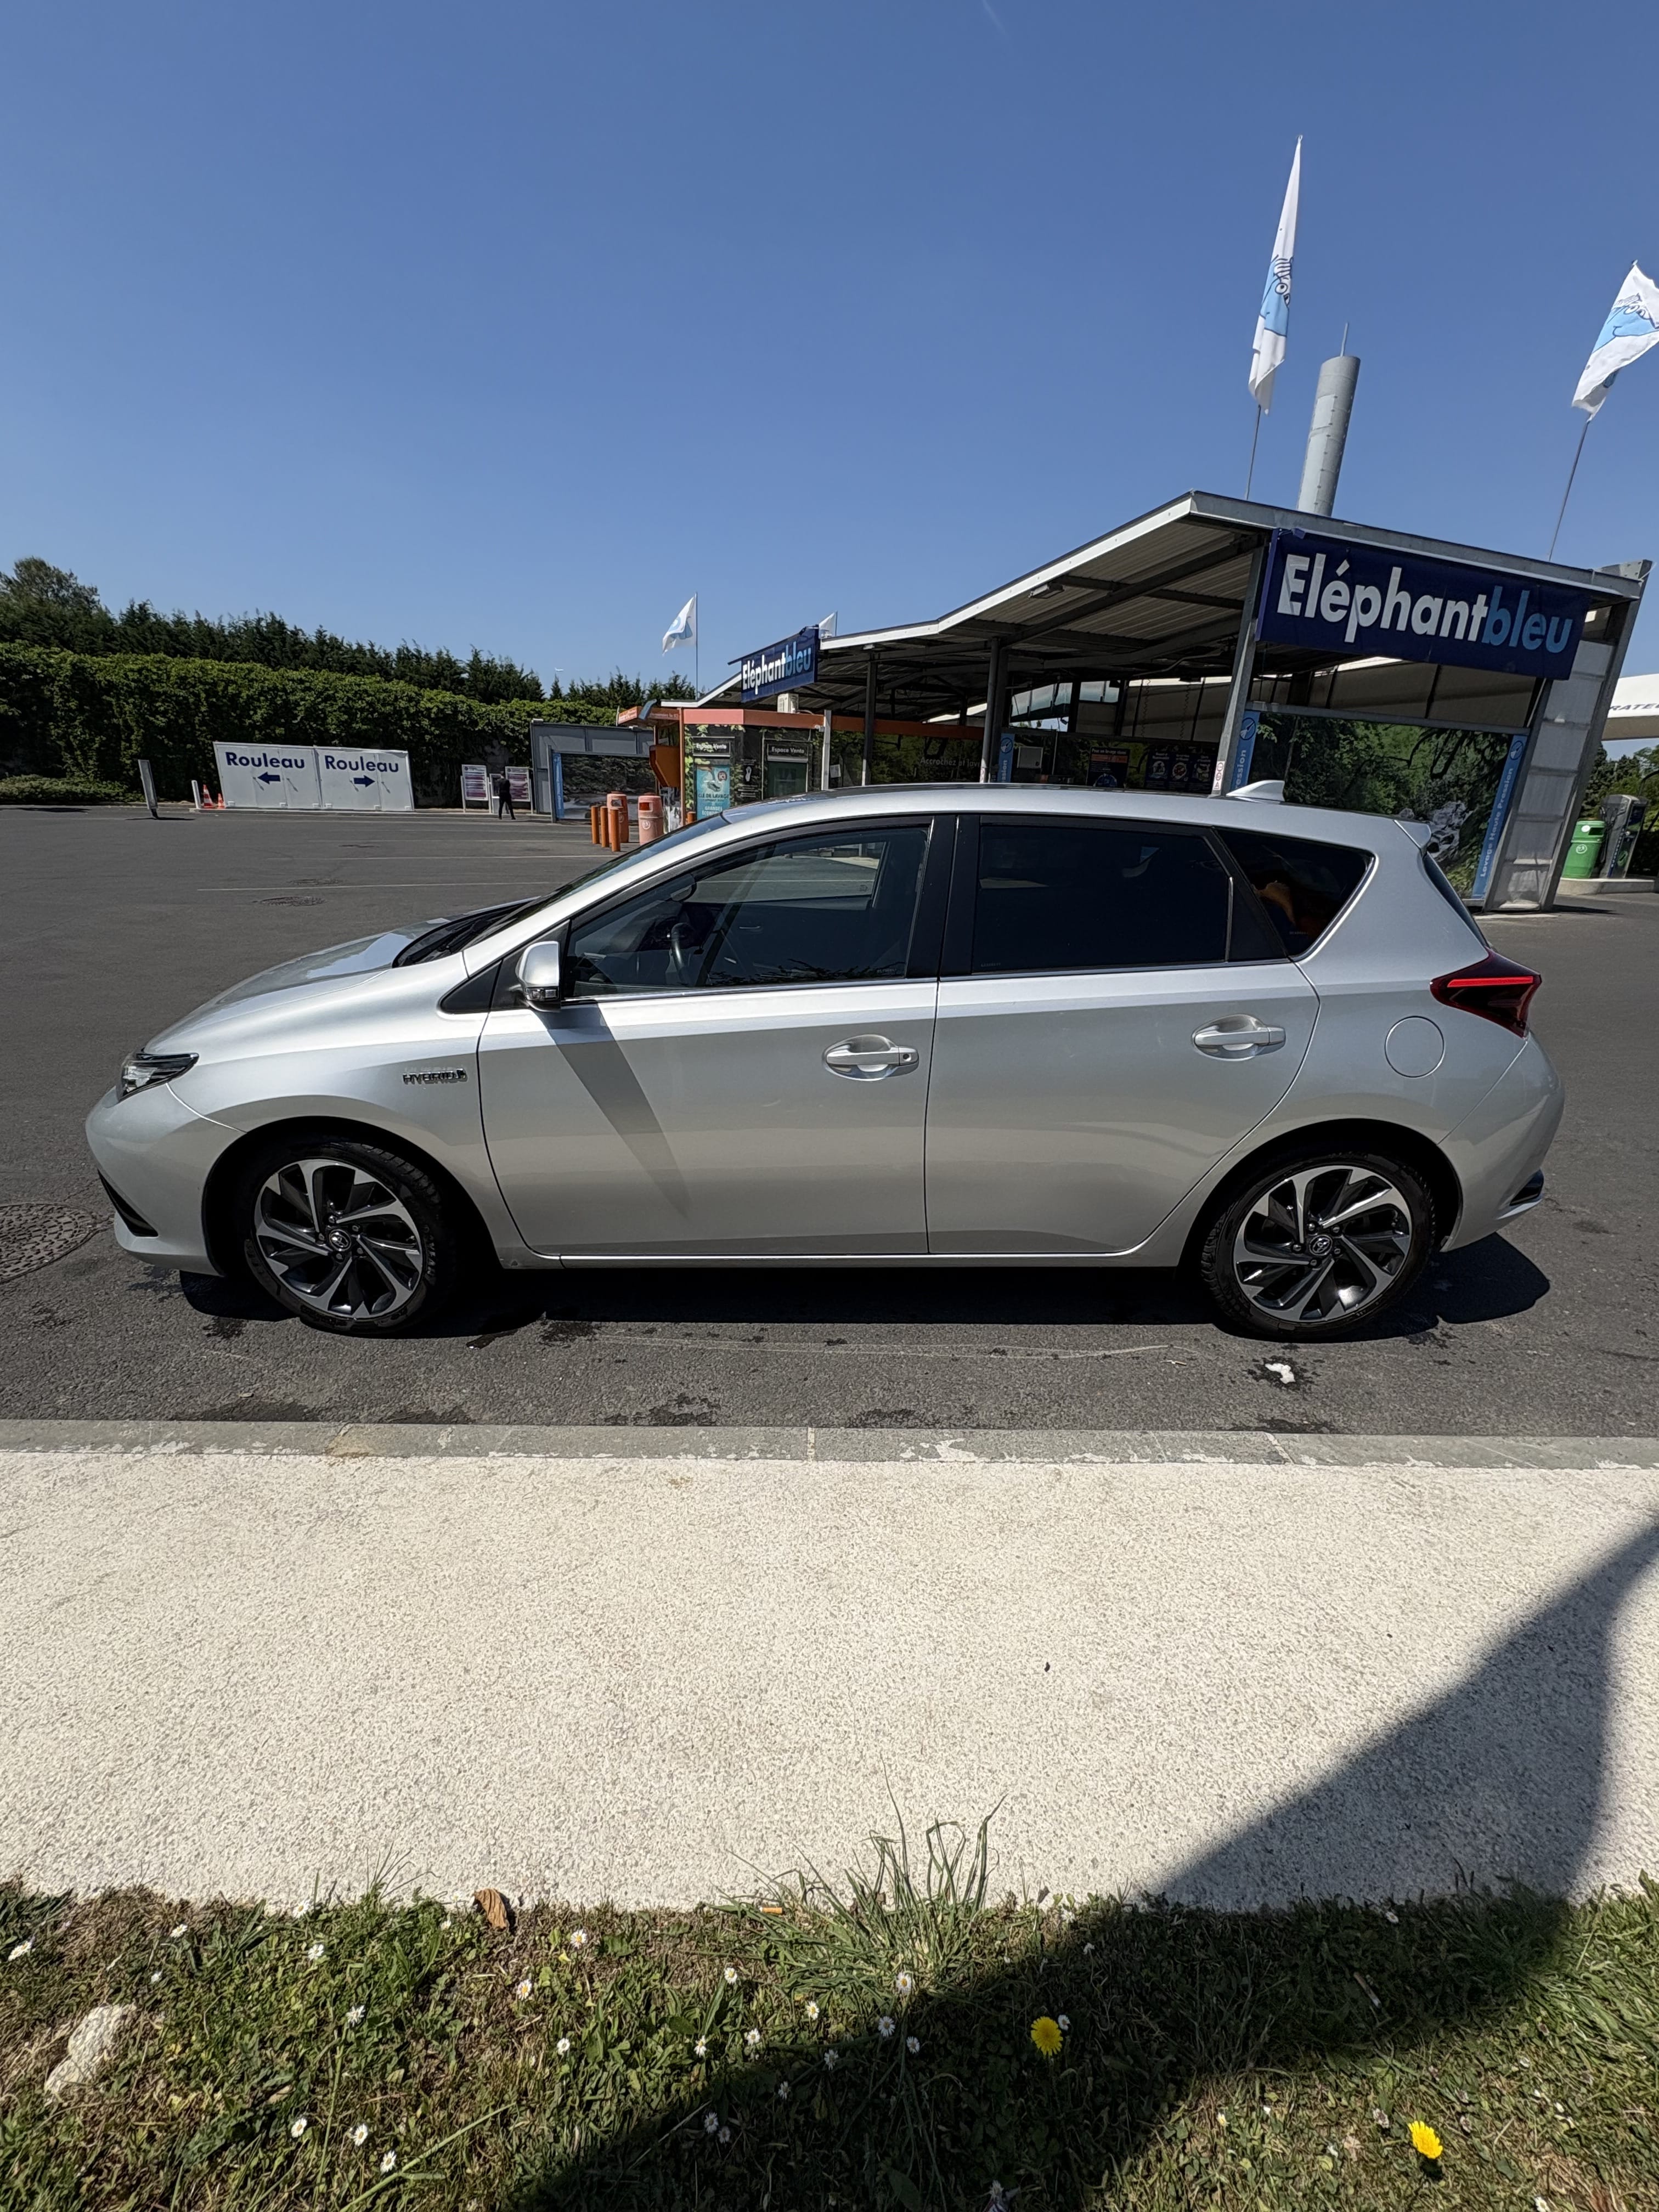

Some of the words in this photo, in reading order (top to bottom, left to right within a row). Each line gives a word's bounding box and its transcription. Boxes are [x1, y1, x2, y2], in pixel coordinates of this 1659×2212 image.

[225, 752, 305, 769] Rouleau
[324, 755, 399, 773] Rouleau
[1481, 843, 1493, 877] Lavage
[1489, 811, 1500, 841] Haute
[1498, 768, 1513, 809] Pression
